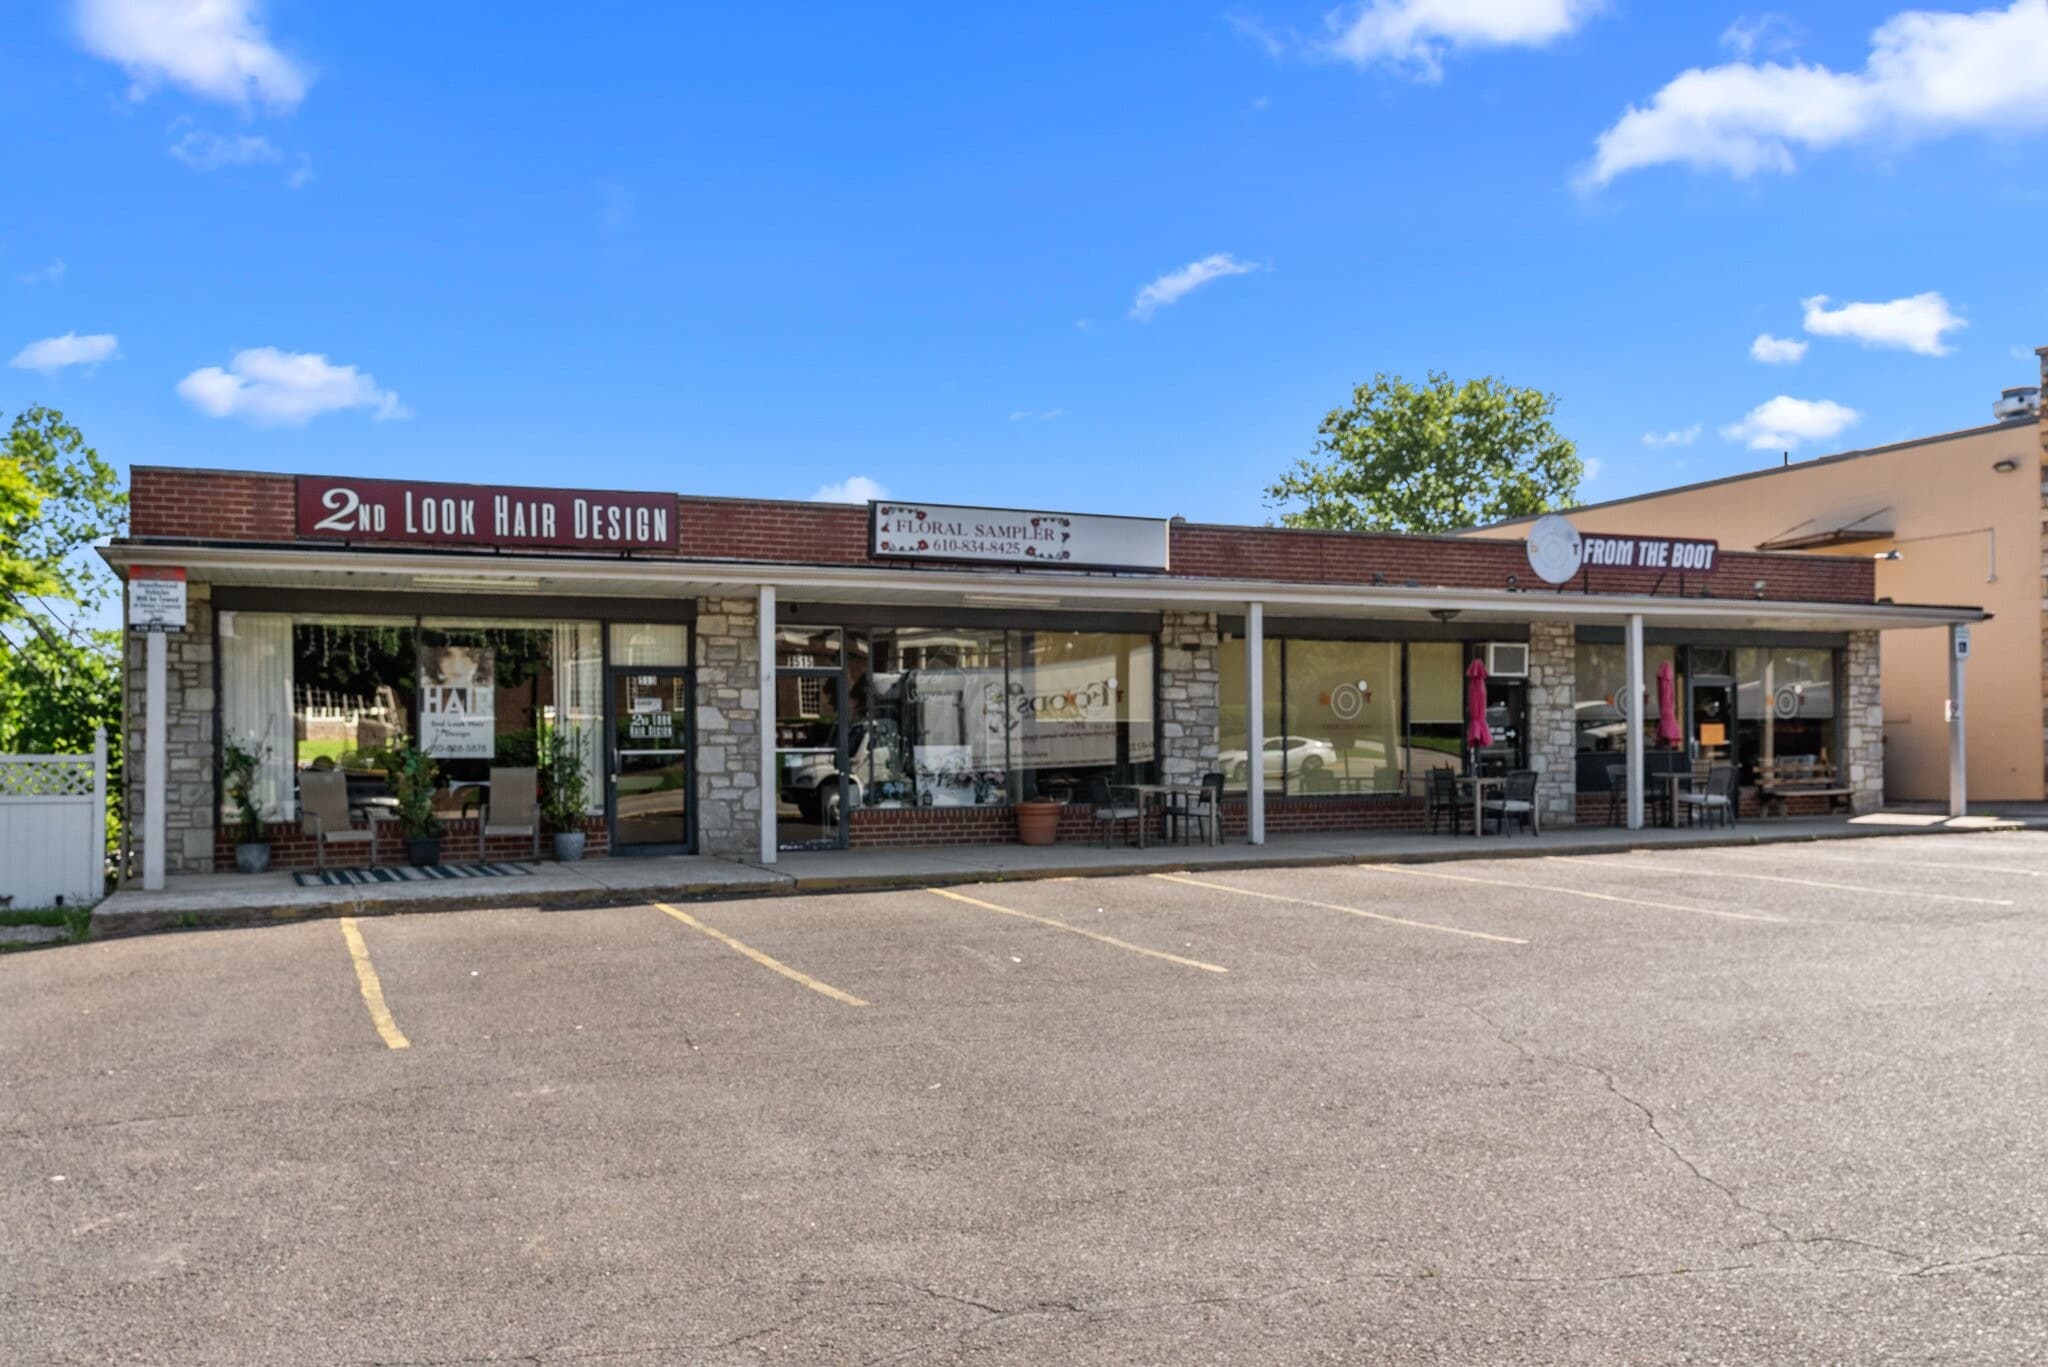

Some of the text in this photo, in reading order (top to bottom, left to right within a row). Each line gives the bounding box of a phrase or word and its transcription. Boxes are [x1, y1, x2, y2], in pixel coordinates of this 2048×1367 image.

[314, 488, 667, 542] 2ND LOOK HAIR DESIGN
[896, 520, 1055, 541] FLORAL SAMPLER
[933, 540, 1020, 555] 610-834-8425
[1583, 538, 1715, 570] FROM THE BOOT
